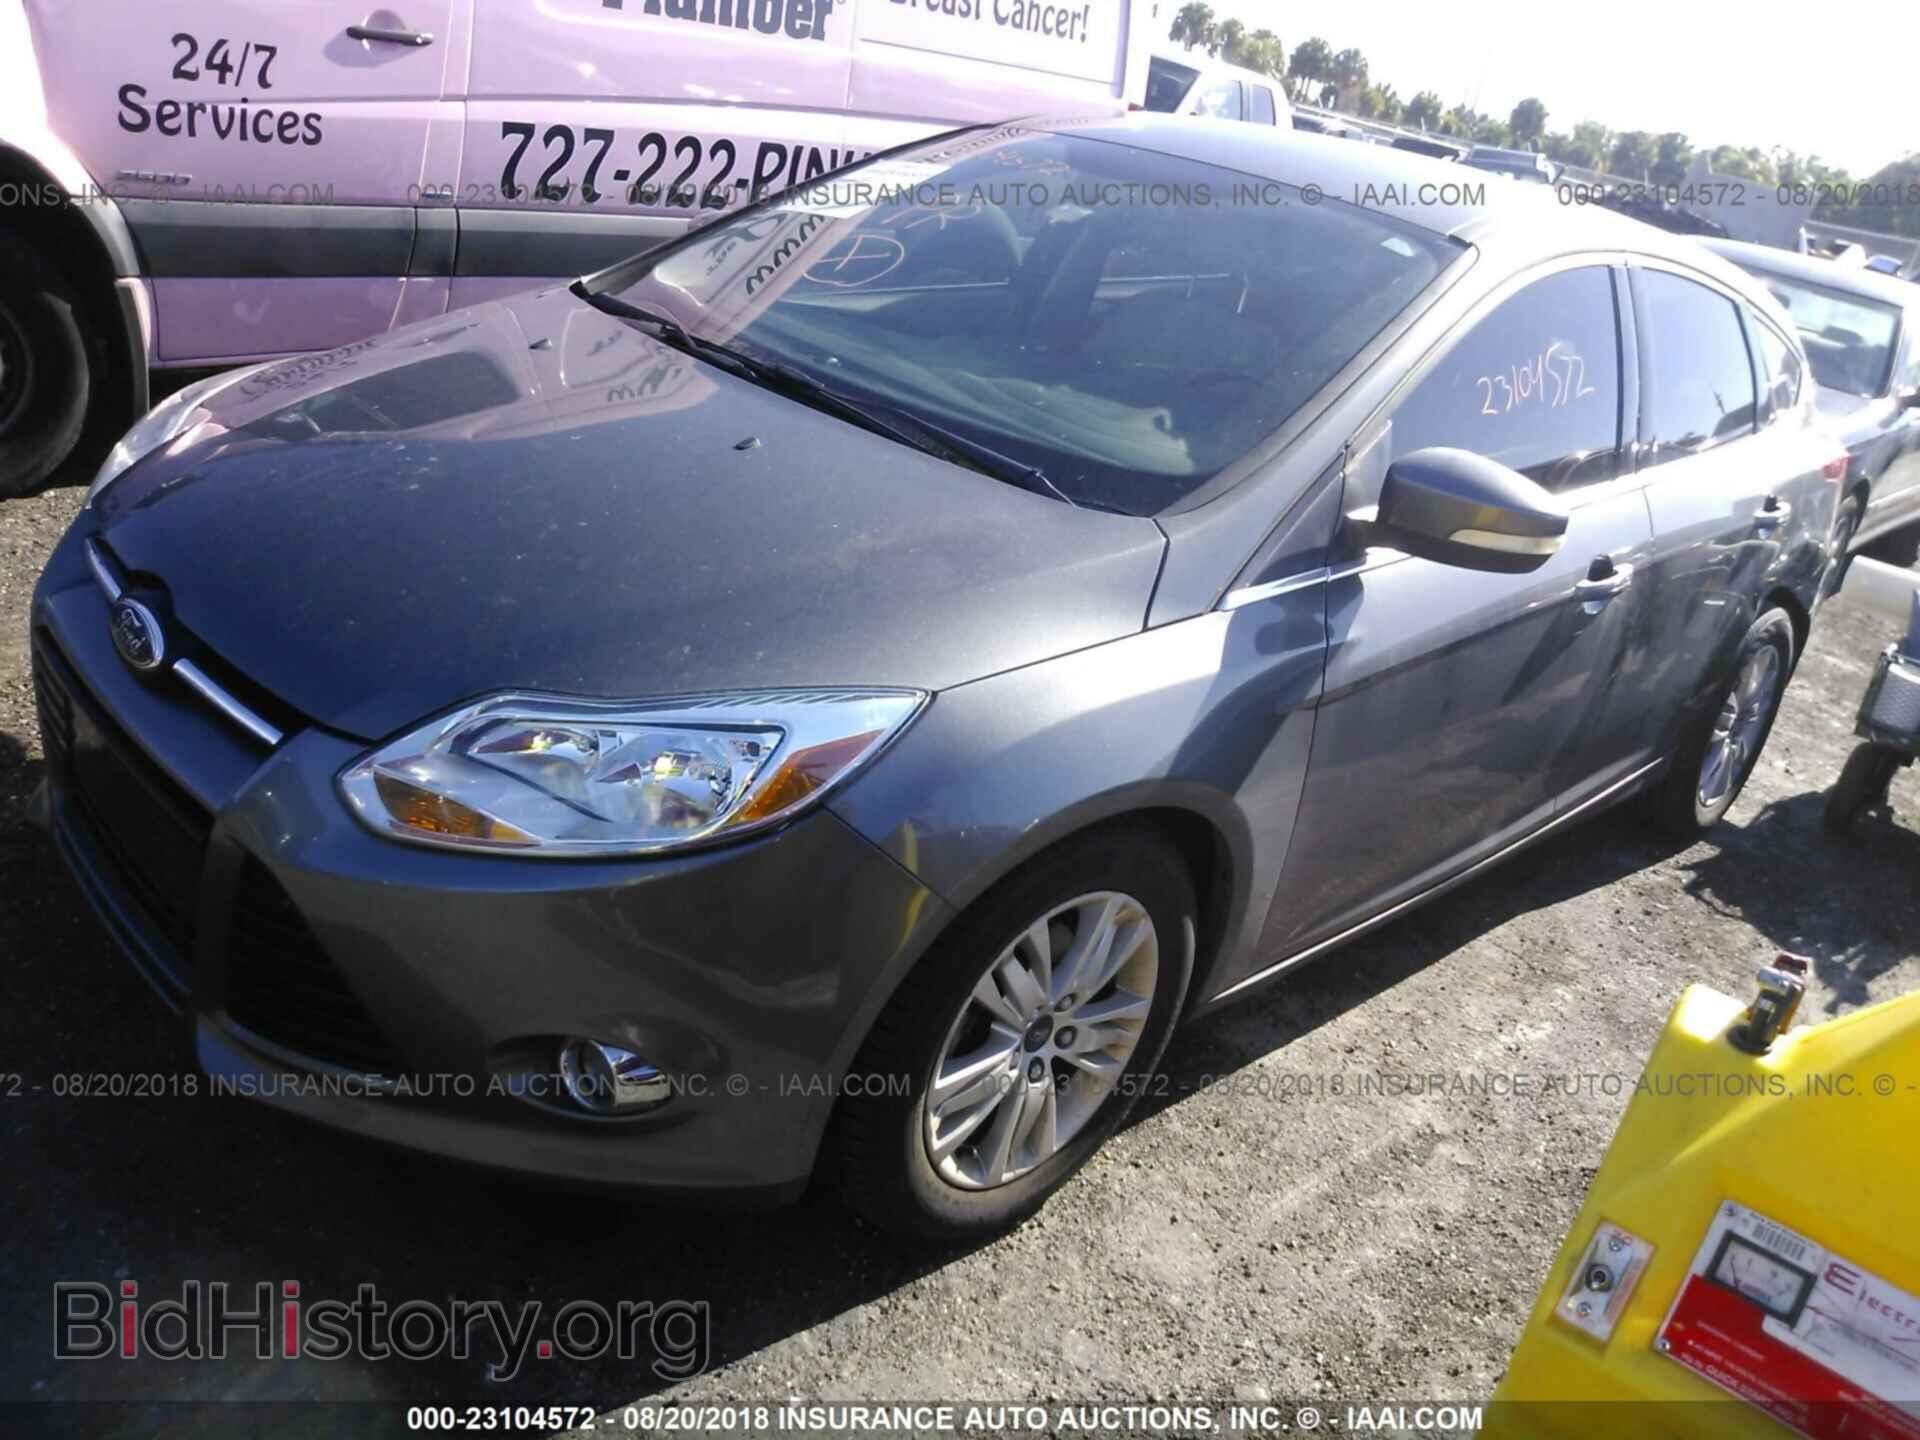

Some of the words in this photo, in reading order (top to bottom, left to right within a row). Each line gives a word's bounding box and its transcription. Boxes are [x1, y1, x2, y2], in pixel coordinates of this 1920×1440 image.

[171, 33, 278, 90] 24/7
[118, 83, 323, 146] Services
[1476, 341, 1596, 415] 23104572
[1824, 1262, 1920, 1336] Electr
